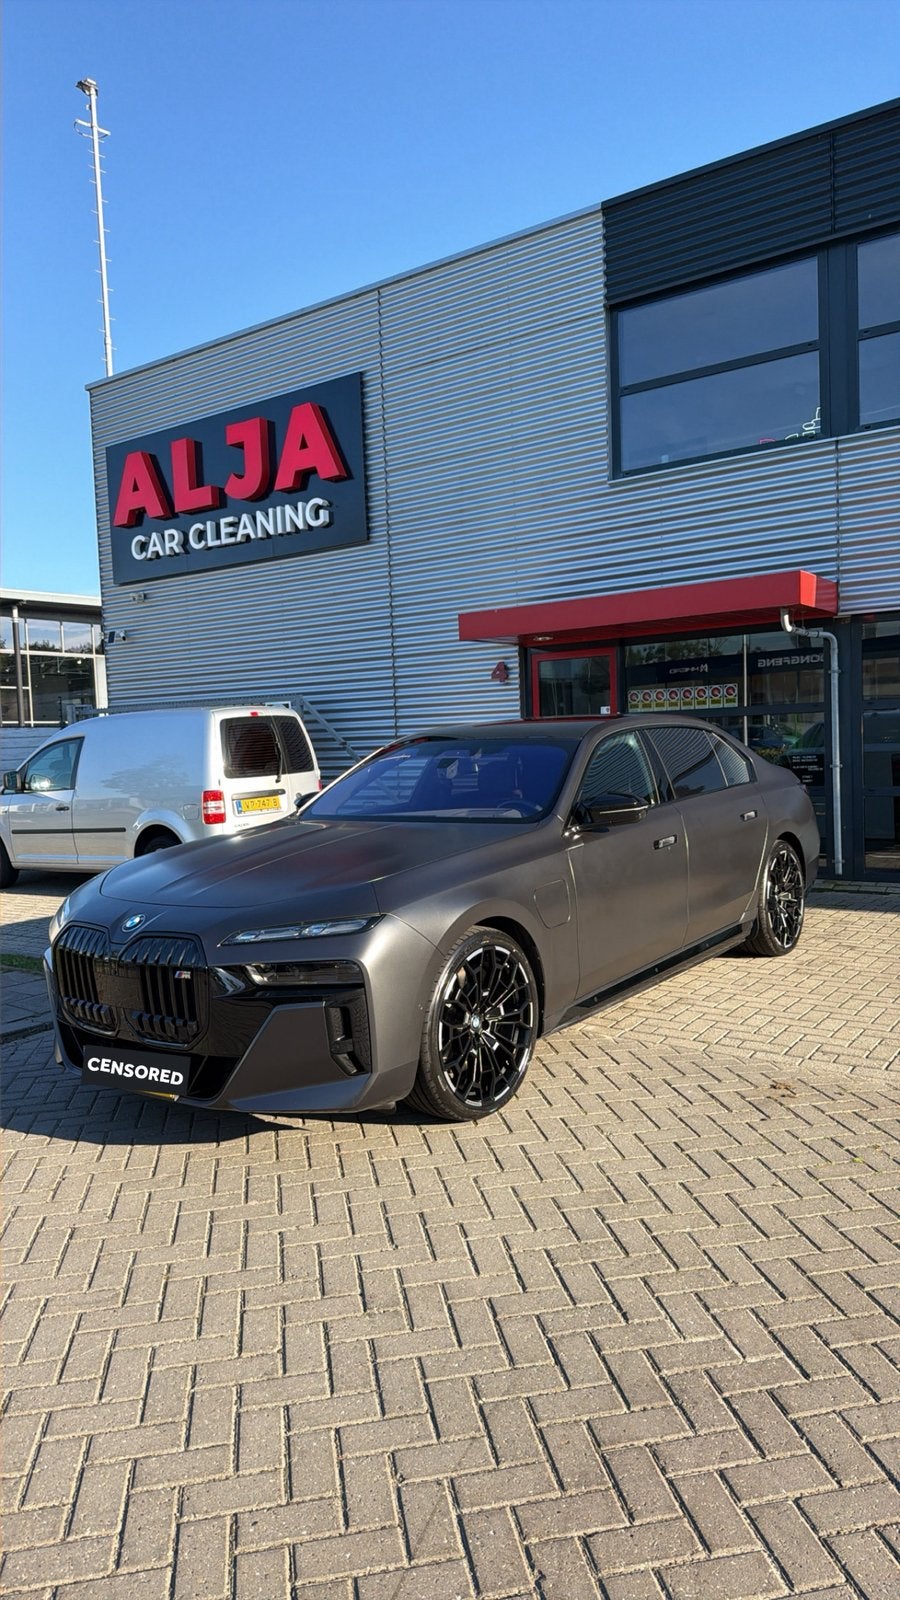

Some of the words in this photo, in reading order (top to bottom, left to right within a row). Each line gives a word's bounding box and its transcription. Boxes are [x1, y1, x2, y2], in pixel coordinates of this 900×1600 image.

[113, 401, 347, 527] ALJA
[131, 529, 185, 560] CAR
[189, 497, 330, 550] CLEANING
[491, 660, 509, 683] 4
